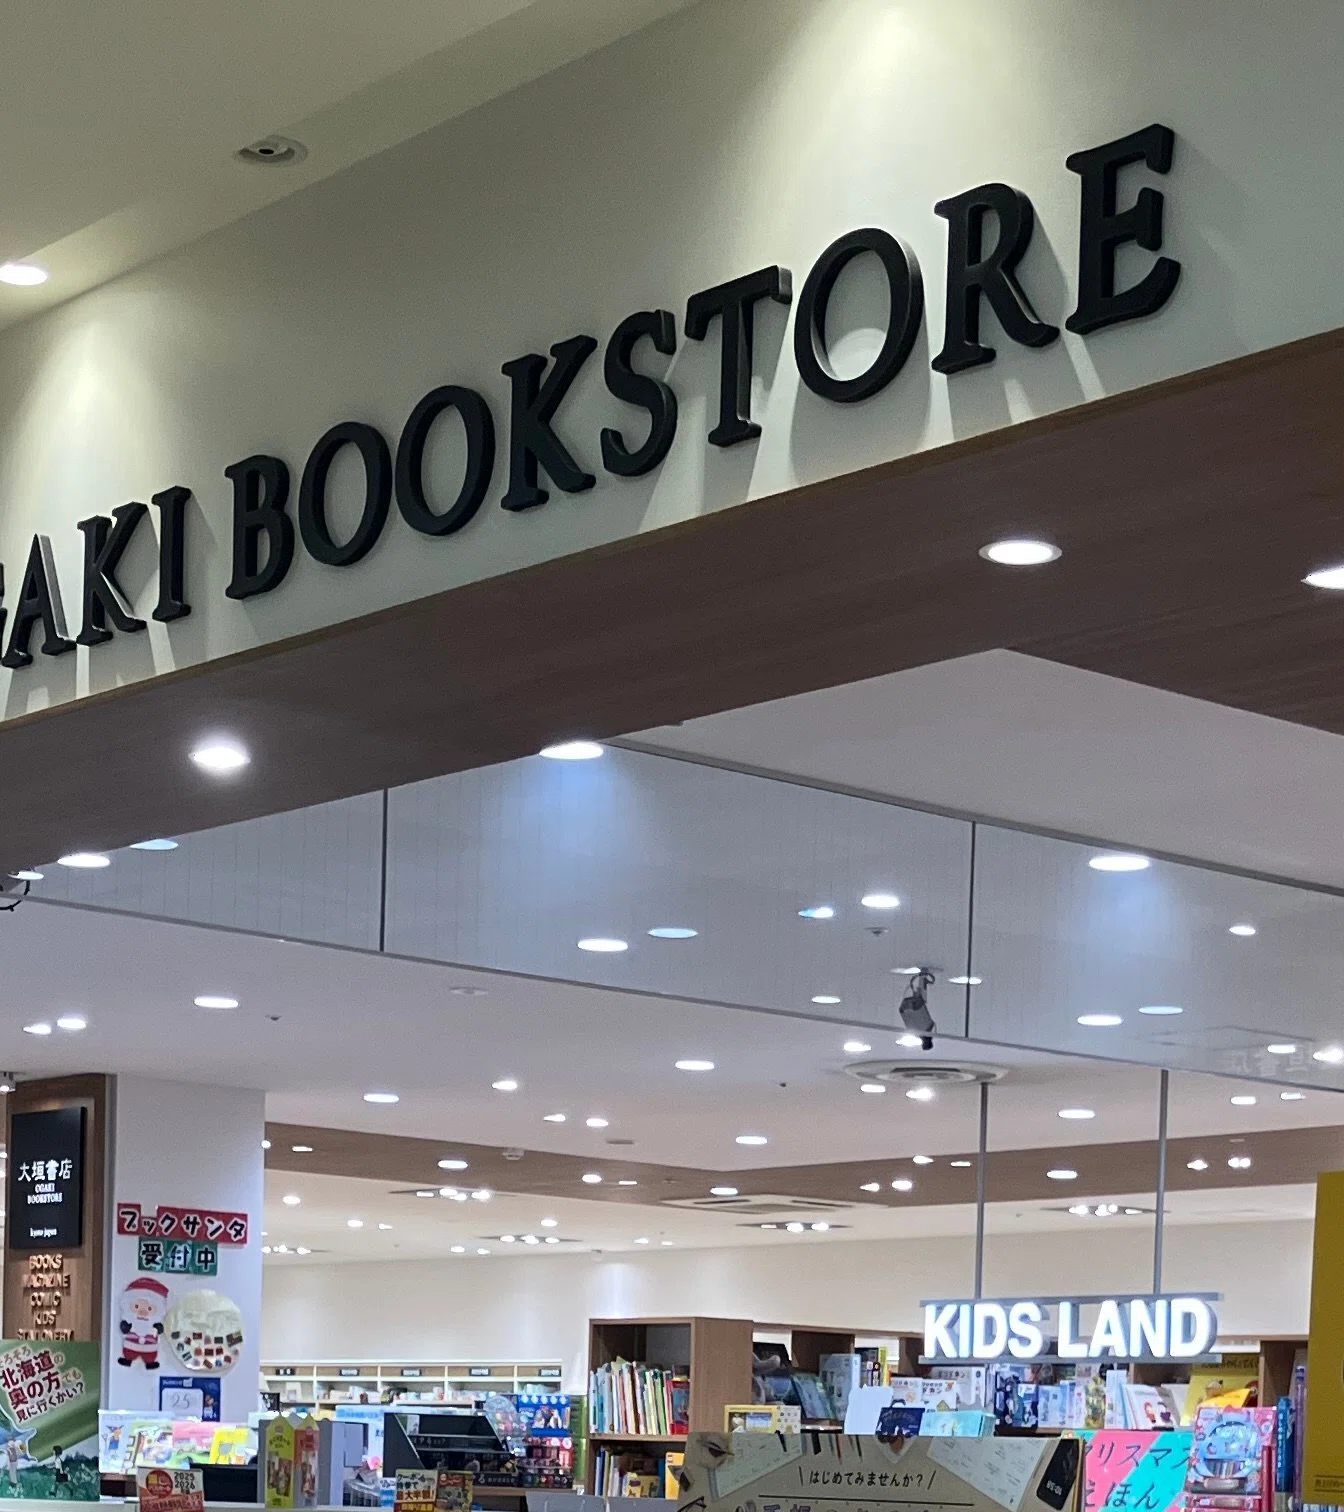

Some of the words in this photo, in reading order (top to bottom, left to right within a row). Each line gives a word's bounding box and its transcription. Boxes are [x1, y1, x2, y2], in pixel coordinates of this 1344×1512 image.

[224, 123, 1182, 602] BOOKSTORE
[17, 1158, 73, 1182] 大垣書店
[119, 1209, 247, 1241] ブックサンタ
[139, 1243, 216, 1273] 受付中
[923, 1301, 1044, 1359] KIDS
[1057, 1299, 1215, 1359] LAND
[809, 1470, 924, 1488] はじめてみませんか？
